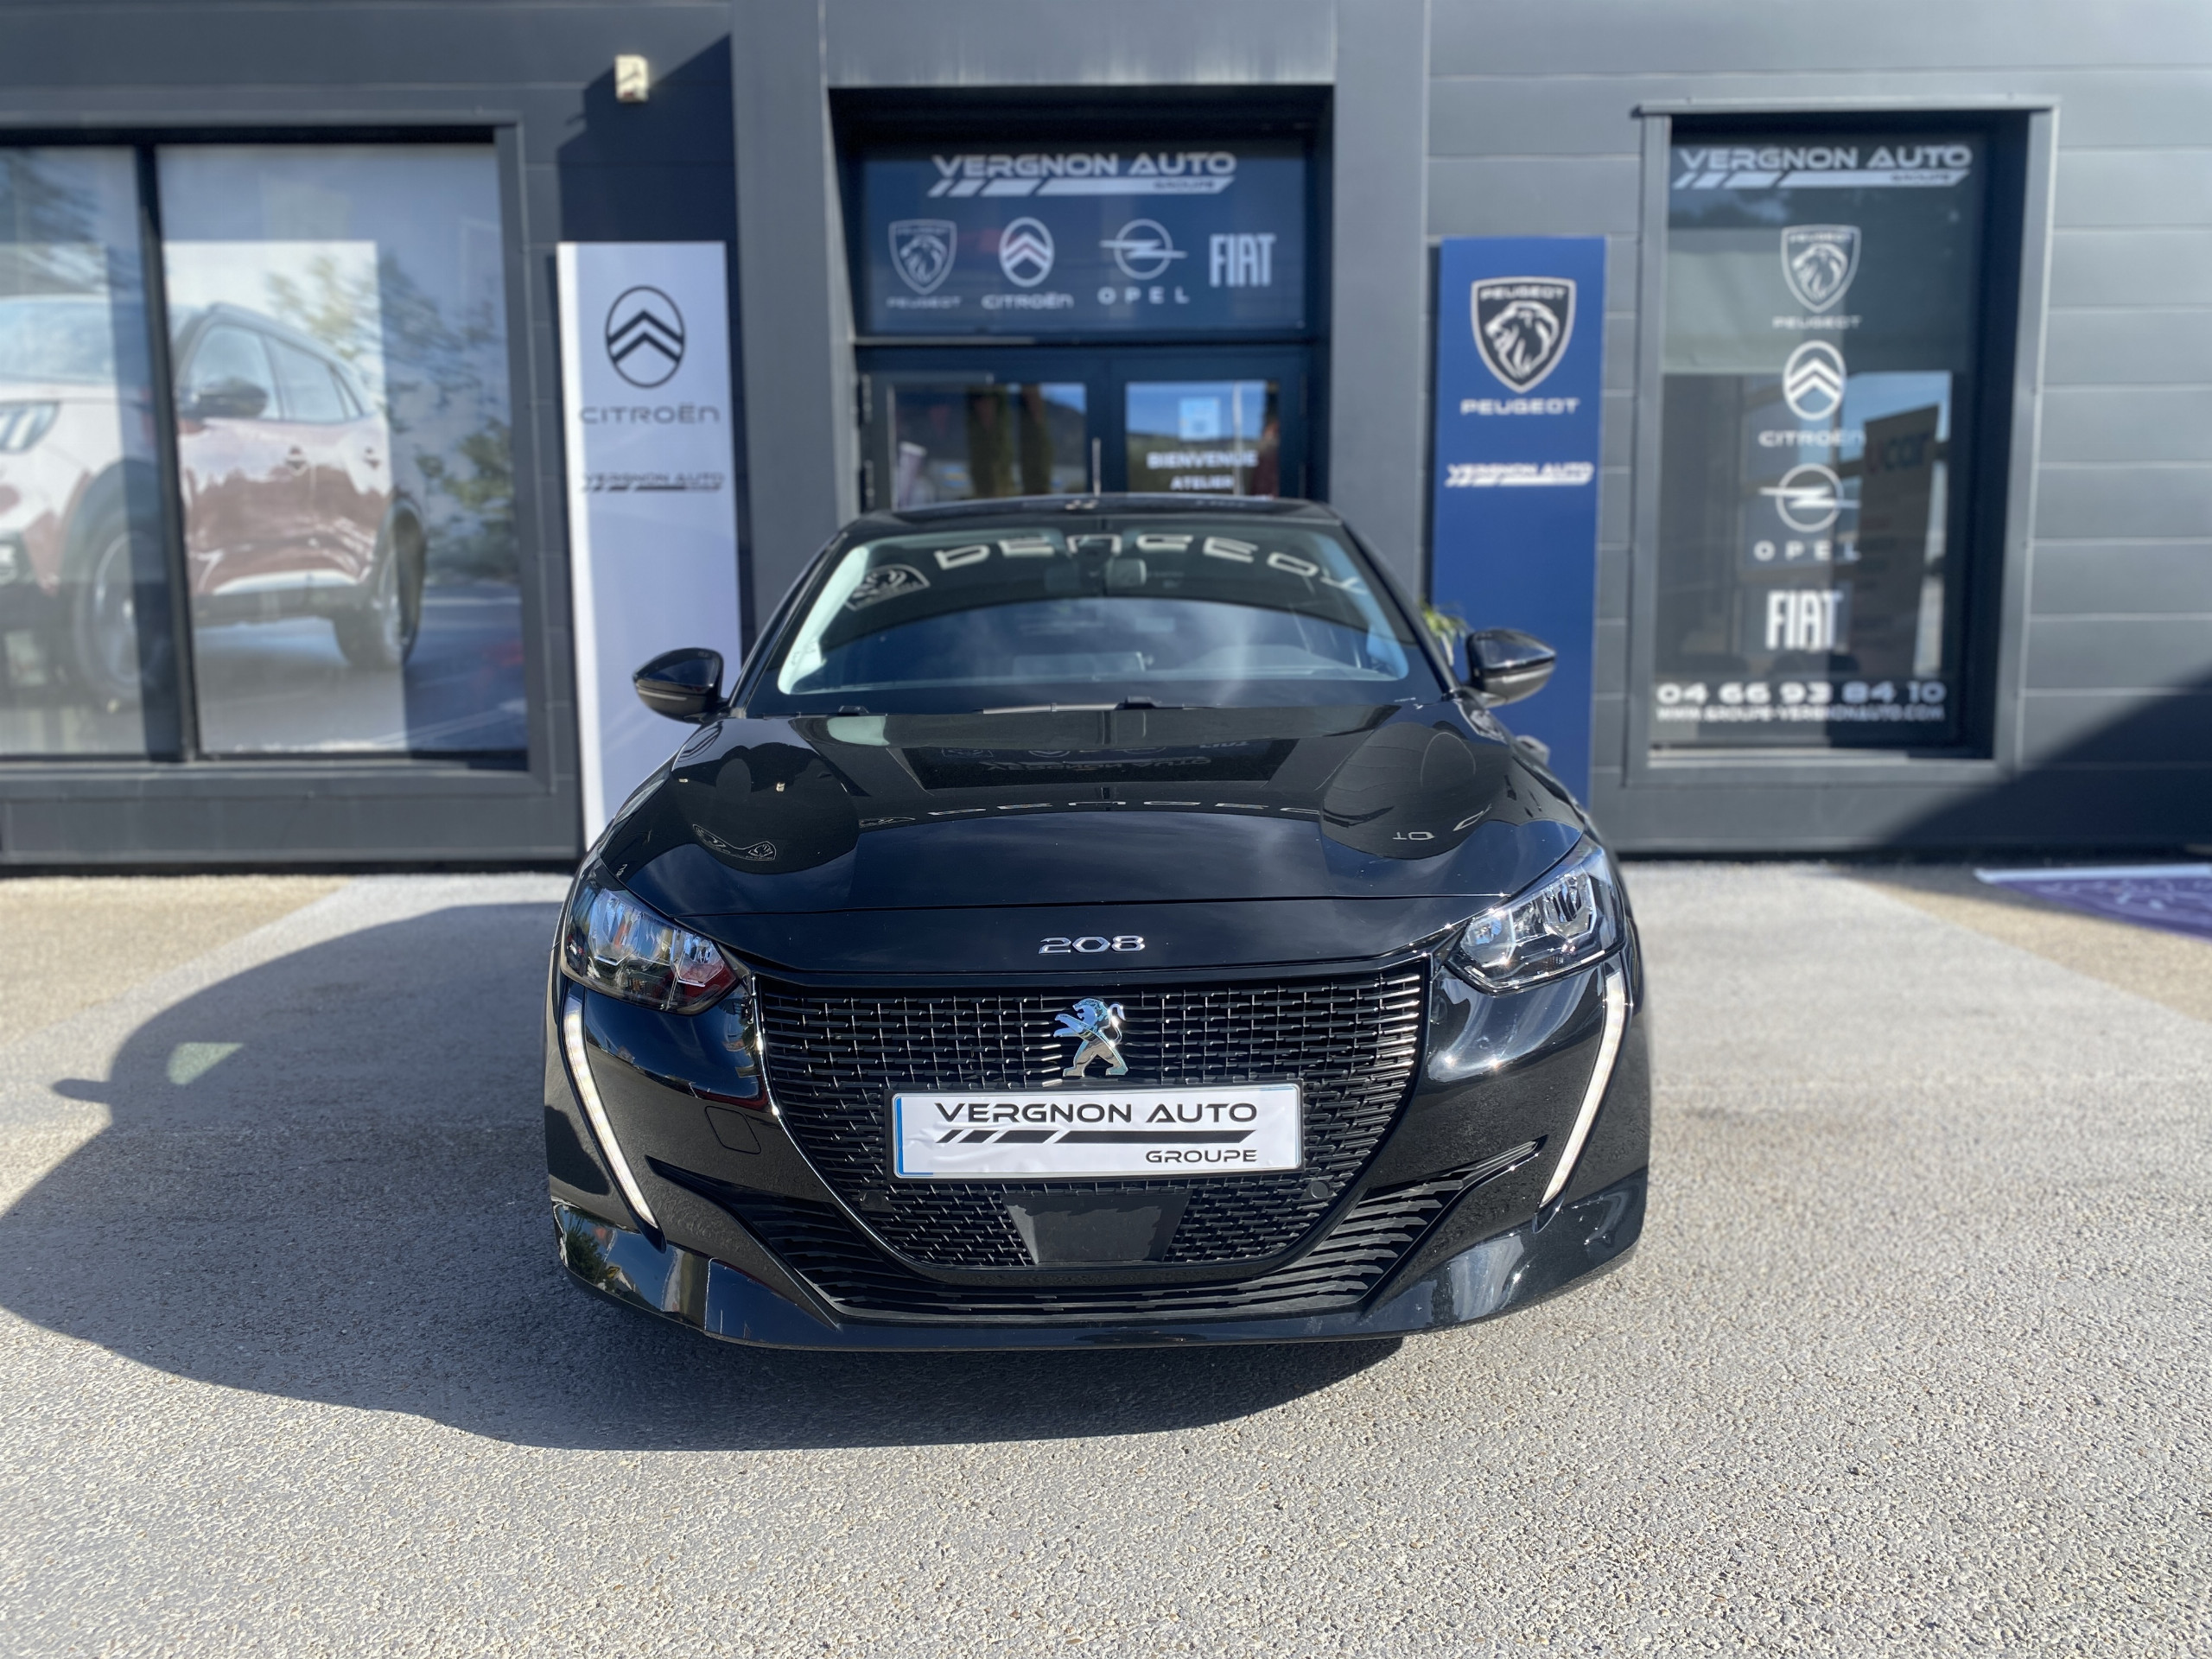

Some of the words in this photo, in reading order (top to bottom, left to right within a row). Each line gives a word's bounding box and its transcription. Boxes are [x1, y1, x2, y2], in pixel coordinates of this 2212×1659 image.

[931, 154, 1119, 177] VERGNON
[1128, 152, 1237, 175] AUTO
[1679, 147, 1859, 170] VERGNON
[1866, 145, 1974, 168] AUTO
[1209, 232, 1276, 287] FIAT
[1097, 286, 1191, 305] OPEL
[1478, 285, 1567, 301] PEUGEOT
[1771, 315, 1863, 330] PEUGEOT
[1459, 397, 1580, 416] PEUGEOT
[1146, 450, 1259, 470] BIENVENUE
[1170, 475, 1235, 491] ATELIER
[1753, 540, 1862, 563] OPEL
[1765, 589, 1845, 651] FIAT
[1656, 683, 1709, 705] 04
[1718, 682, 1771, 704] 66
[1778, 681, 1833, 704] 93
[1907, 681, 1947, 704] 10
[1039, 935, 1146, 955] 208
[934, 1102, 1133, 1124] VERGNON
[1145, 1102, 1259, 1123] AUTO
[1145, 1149, 1259, 1164] GROUPE
